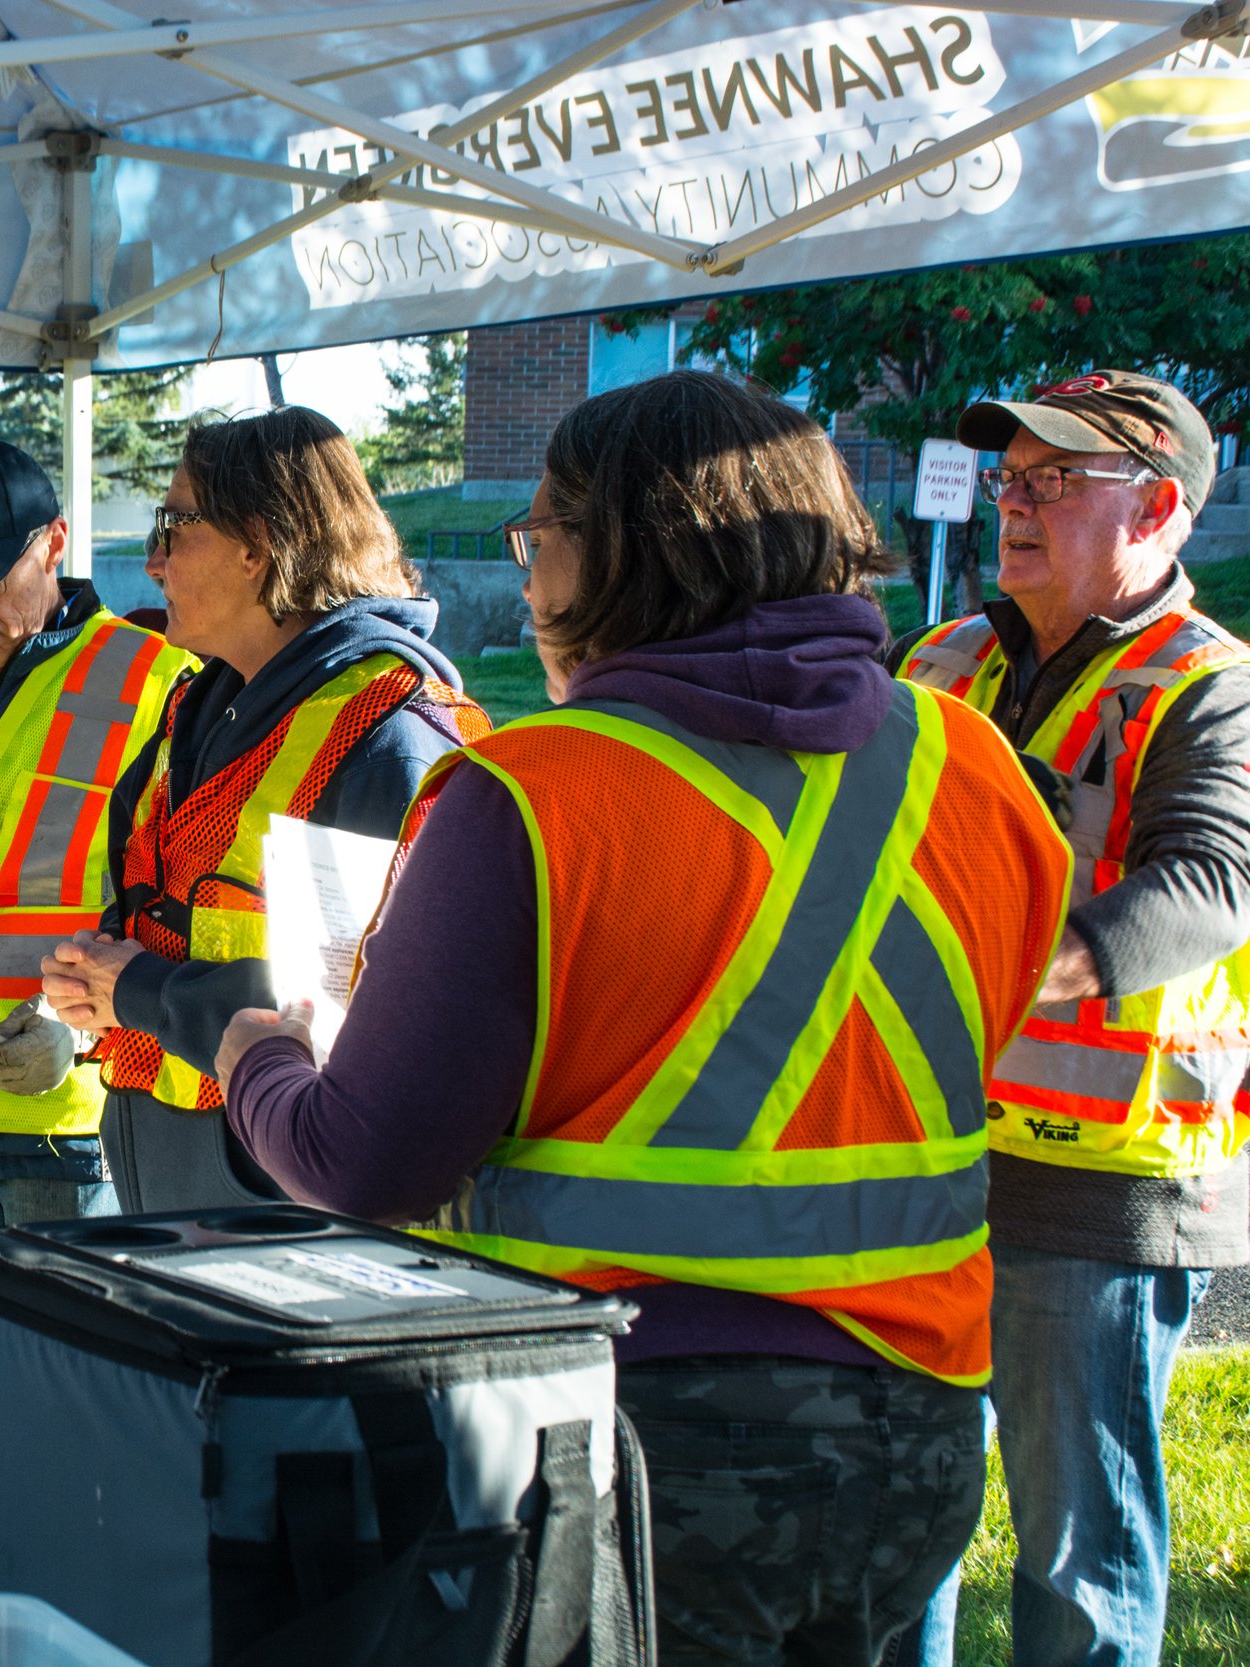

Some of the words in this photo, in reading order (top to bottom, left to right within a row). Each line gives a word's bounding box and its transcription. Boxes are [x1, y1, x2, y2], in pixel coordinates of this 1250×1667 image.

[929, 459, 967, 472] VISITOR
[924, 473, 968, 488] PARKING
[930, 489, 958, 502] ONLY
[1024, 1117, 1080, 1142] VIKING
